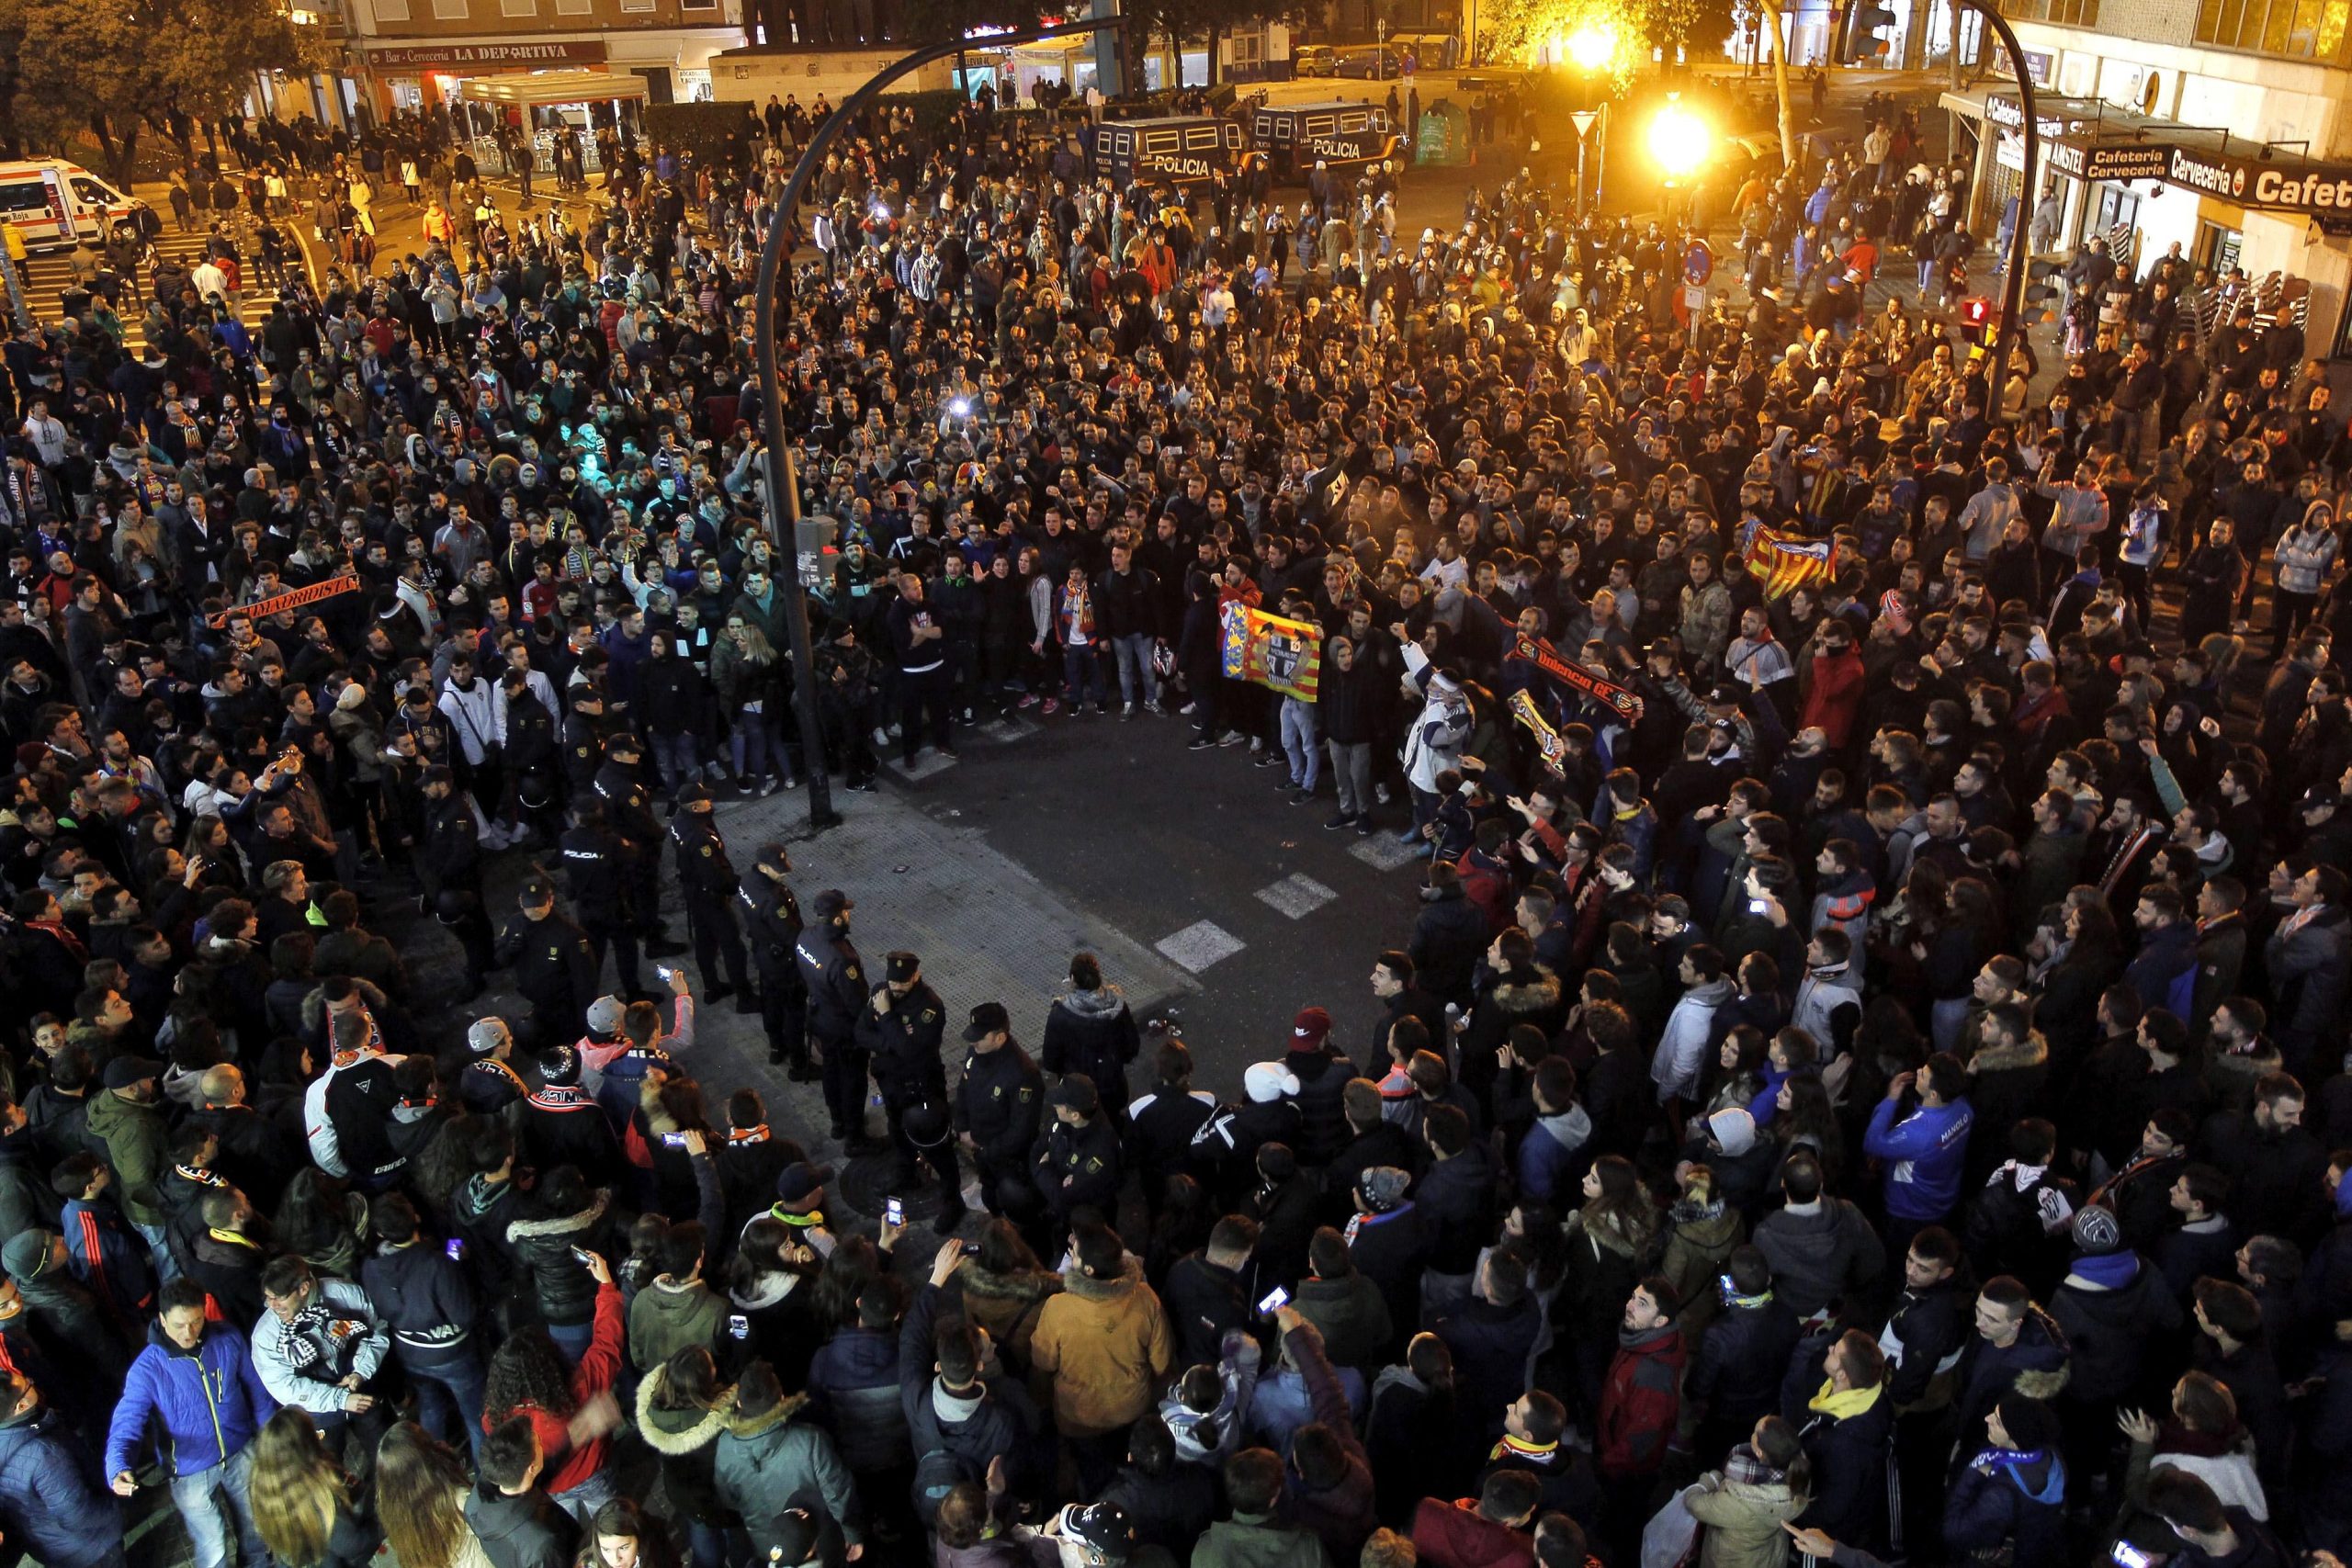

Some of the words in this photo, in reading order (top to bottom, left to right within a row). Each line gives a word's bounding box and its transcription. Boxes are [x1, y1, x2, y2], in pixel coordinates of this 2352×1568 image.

[385, 50, 401, 62] Bar
[455, 48, 474, 61] LA
[479, 45, 568, 60] DEPORTIVA
[1992, 96, 2022, 127] Cafetería
[1313, 139, 1360, 159] POLICIA
[2051, 141, 2086, 175] AMSTEL
[2094, 148, 2163, 164] Cafetería
[1154, 154, 1209, 177] POLICIA
[2086, 164, 2166, 178] Cervecería
[2171, 149, 2231, 196] Cervecería
[2255, 170, 2352, 209] Cafet
[13, 212, 30, 221] Roja
[563, 850, 599, 859] POLICIA
[1940, 1113, 1969, 1143] MANOLO
